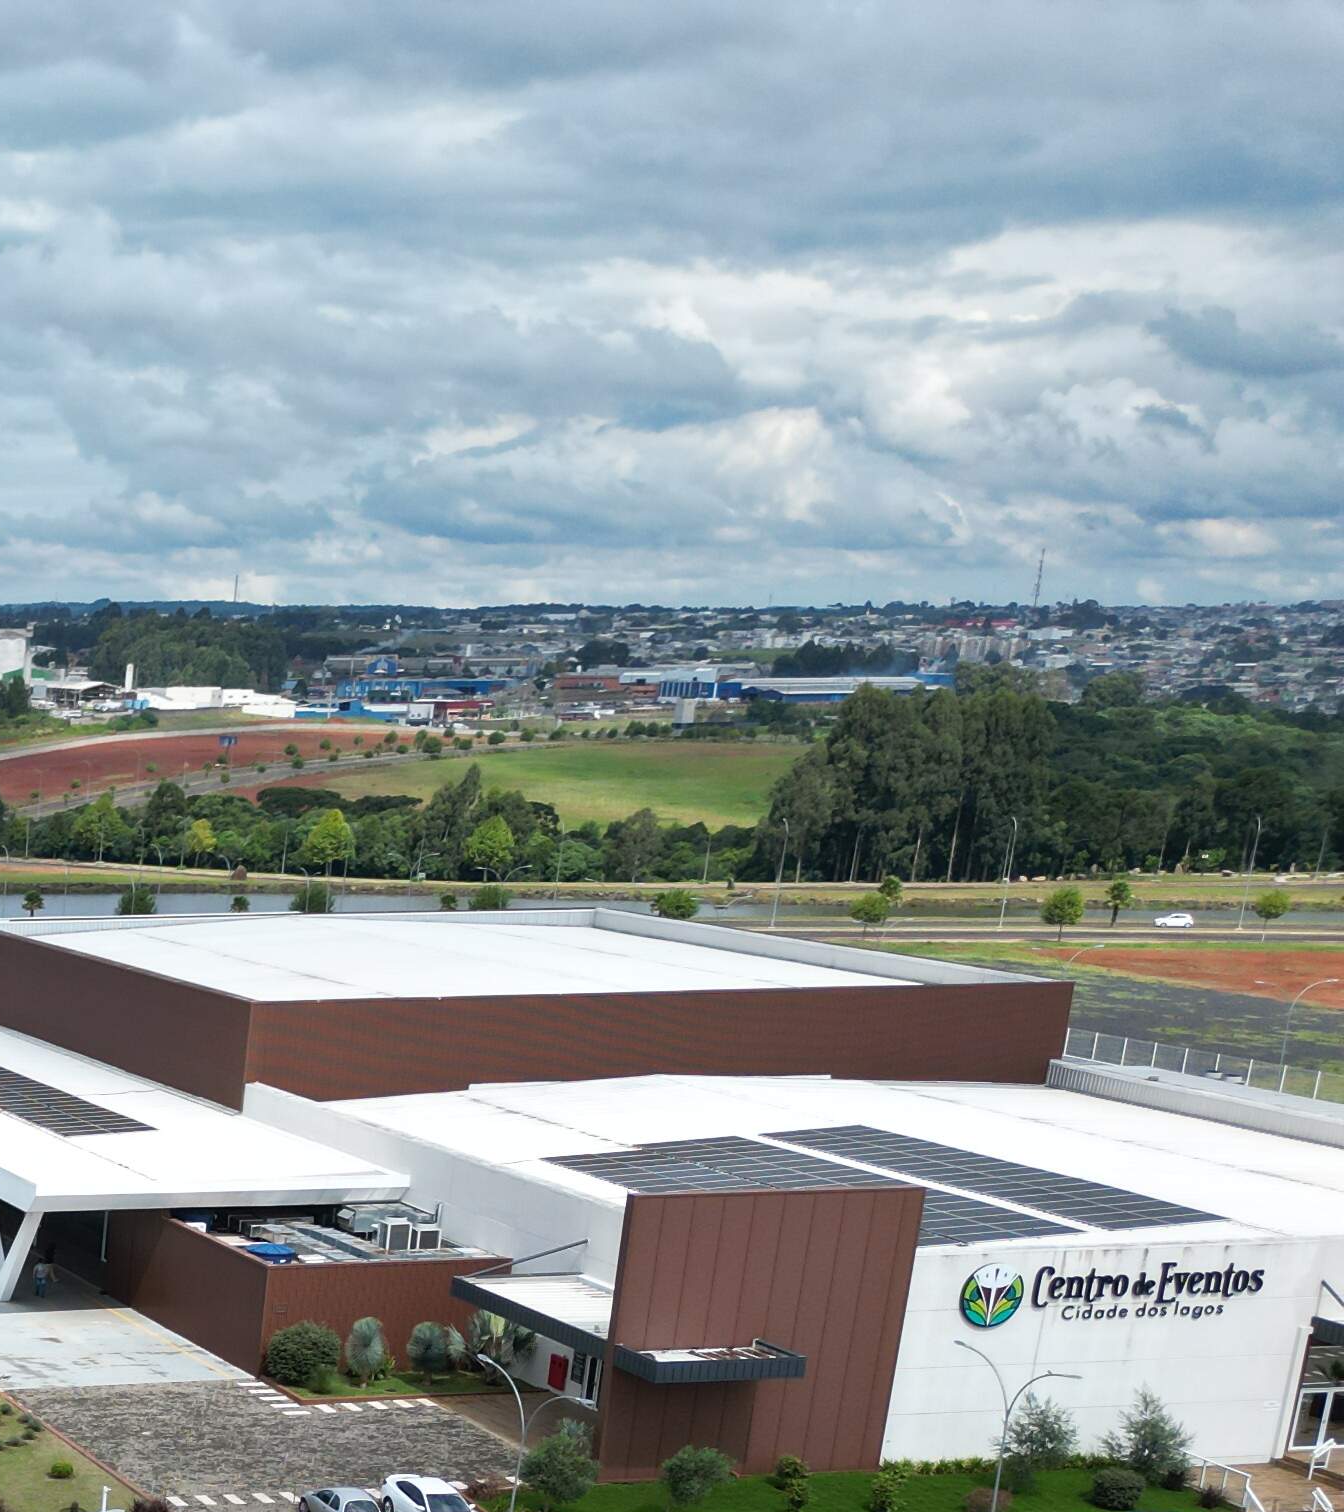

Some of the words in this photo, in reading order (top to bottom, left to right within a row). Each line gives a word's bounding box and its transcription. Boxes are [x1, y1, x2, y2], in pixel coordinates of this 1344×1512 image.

[1031, 1266, 1129, 1308] Centro
[1132, 1272, 1155, 1296] de
[1155, 1262, 1265, 1304] Eventos
[1061, 1304, 1129, 1321] Cidade
[1136, 1302, 1167, 1318] dos
